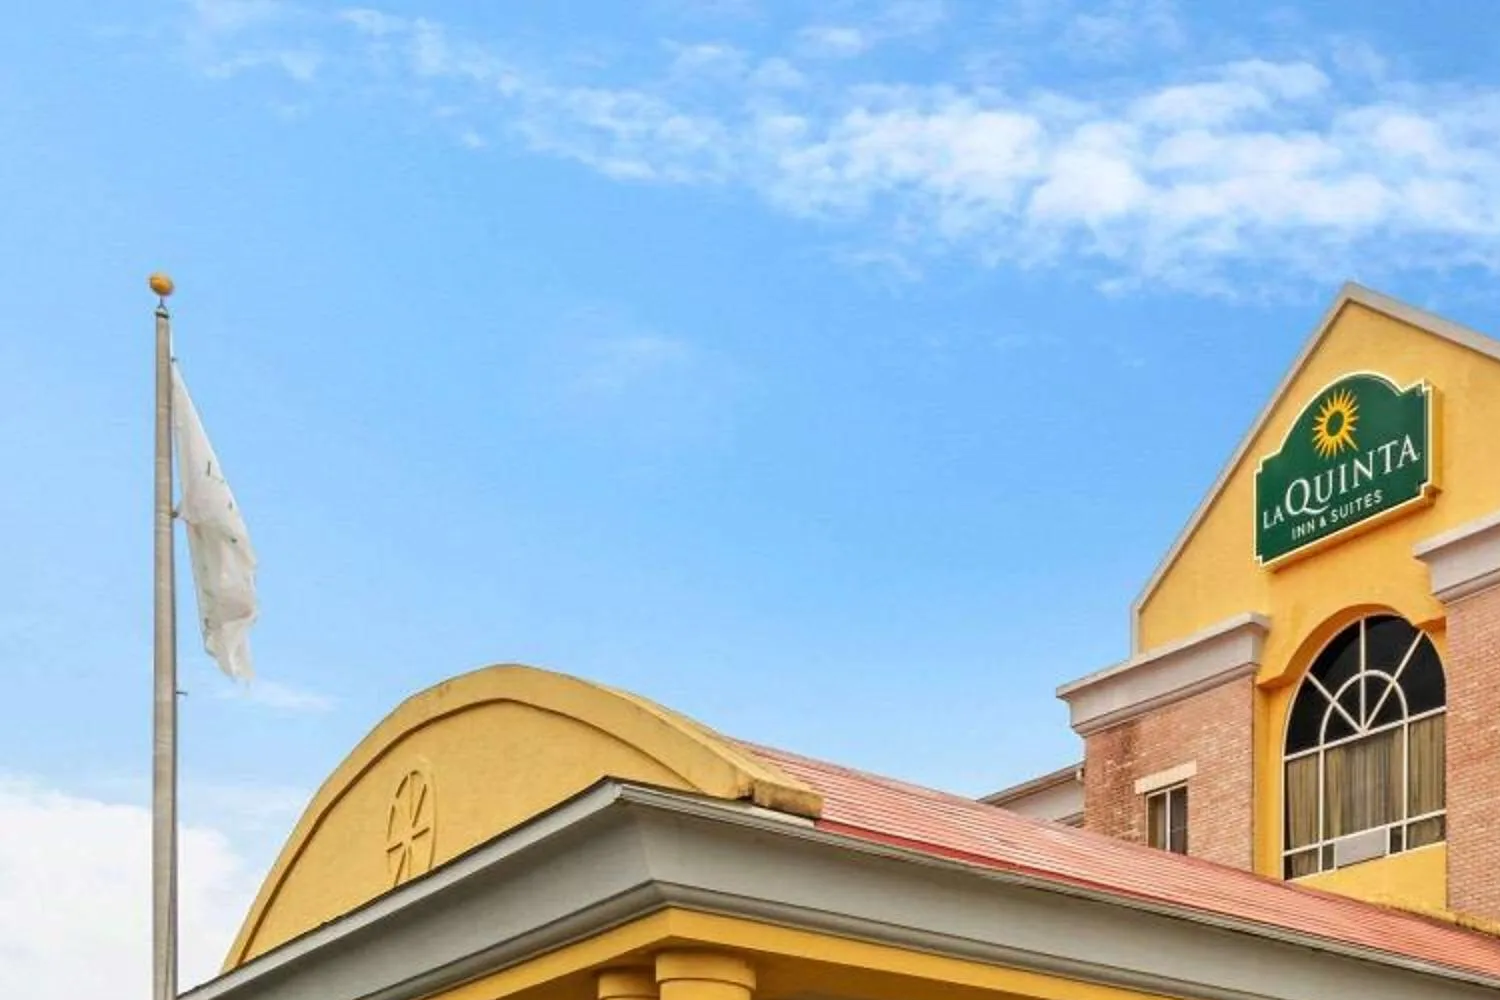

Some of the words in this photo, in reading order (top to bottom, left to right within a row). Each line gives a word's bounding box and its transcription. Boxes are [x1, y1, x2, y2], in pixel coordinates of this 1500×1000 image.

[1263, 505, 1285, 529] LA
[1285, 433, 1419, 516] QUINTA
[1291, 519, 1315, 540] INN
[1319, 518, 1327, 528] &
[1330, 489, 1383, 522] SUITES
